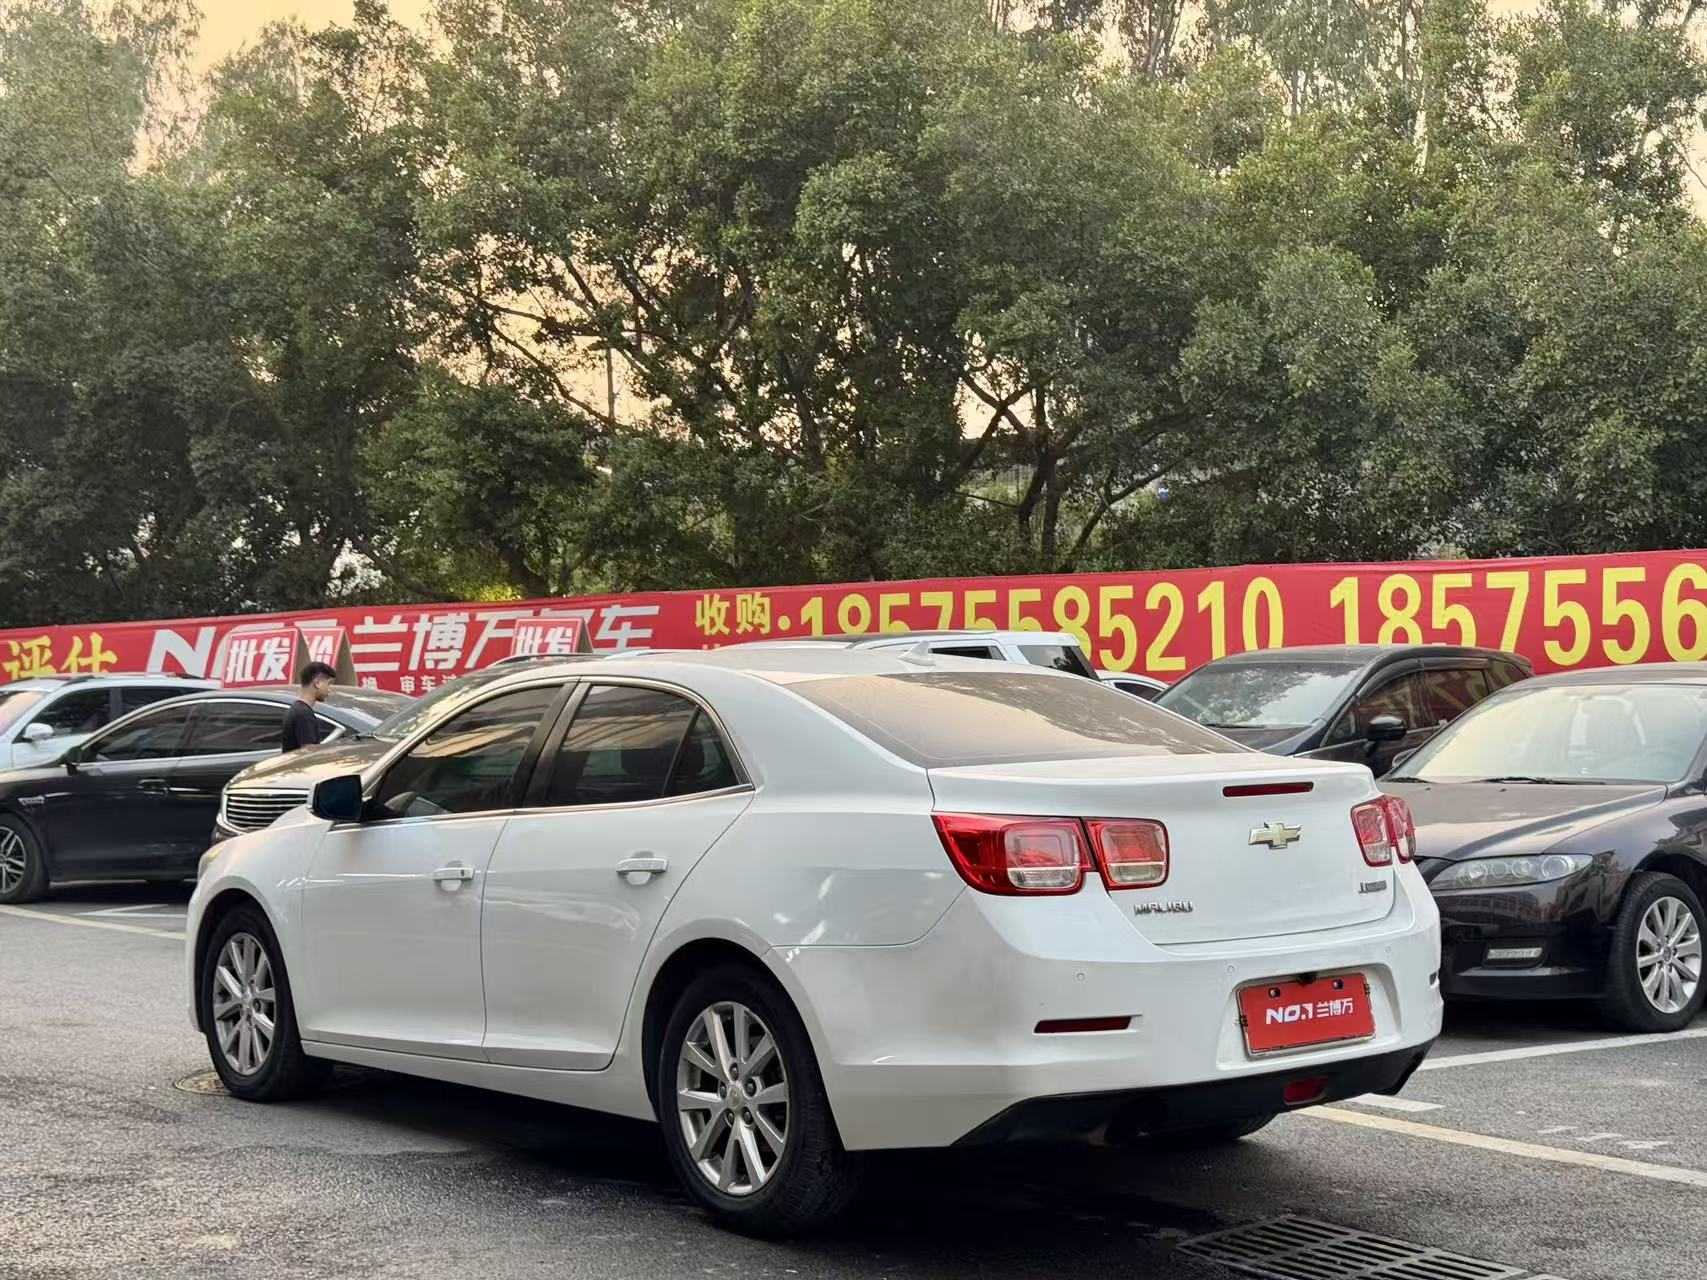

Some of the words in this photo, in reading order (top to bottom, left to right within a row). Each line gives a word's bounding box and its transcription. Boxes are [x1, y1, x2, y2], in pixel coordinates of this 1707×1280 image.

[695, 591, 771, 636] 收购
[225, 636, 290, 683] 批发
[351, 605, 660, 673] 兰博万车
[1266, 1002, 1313, 1025] NO.1
